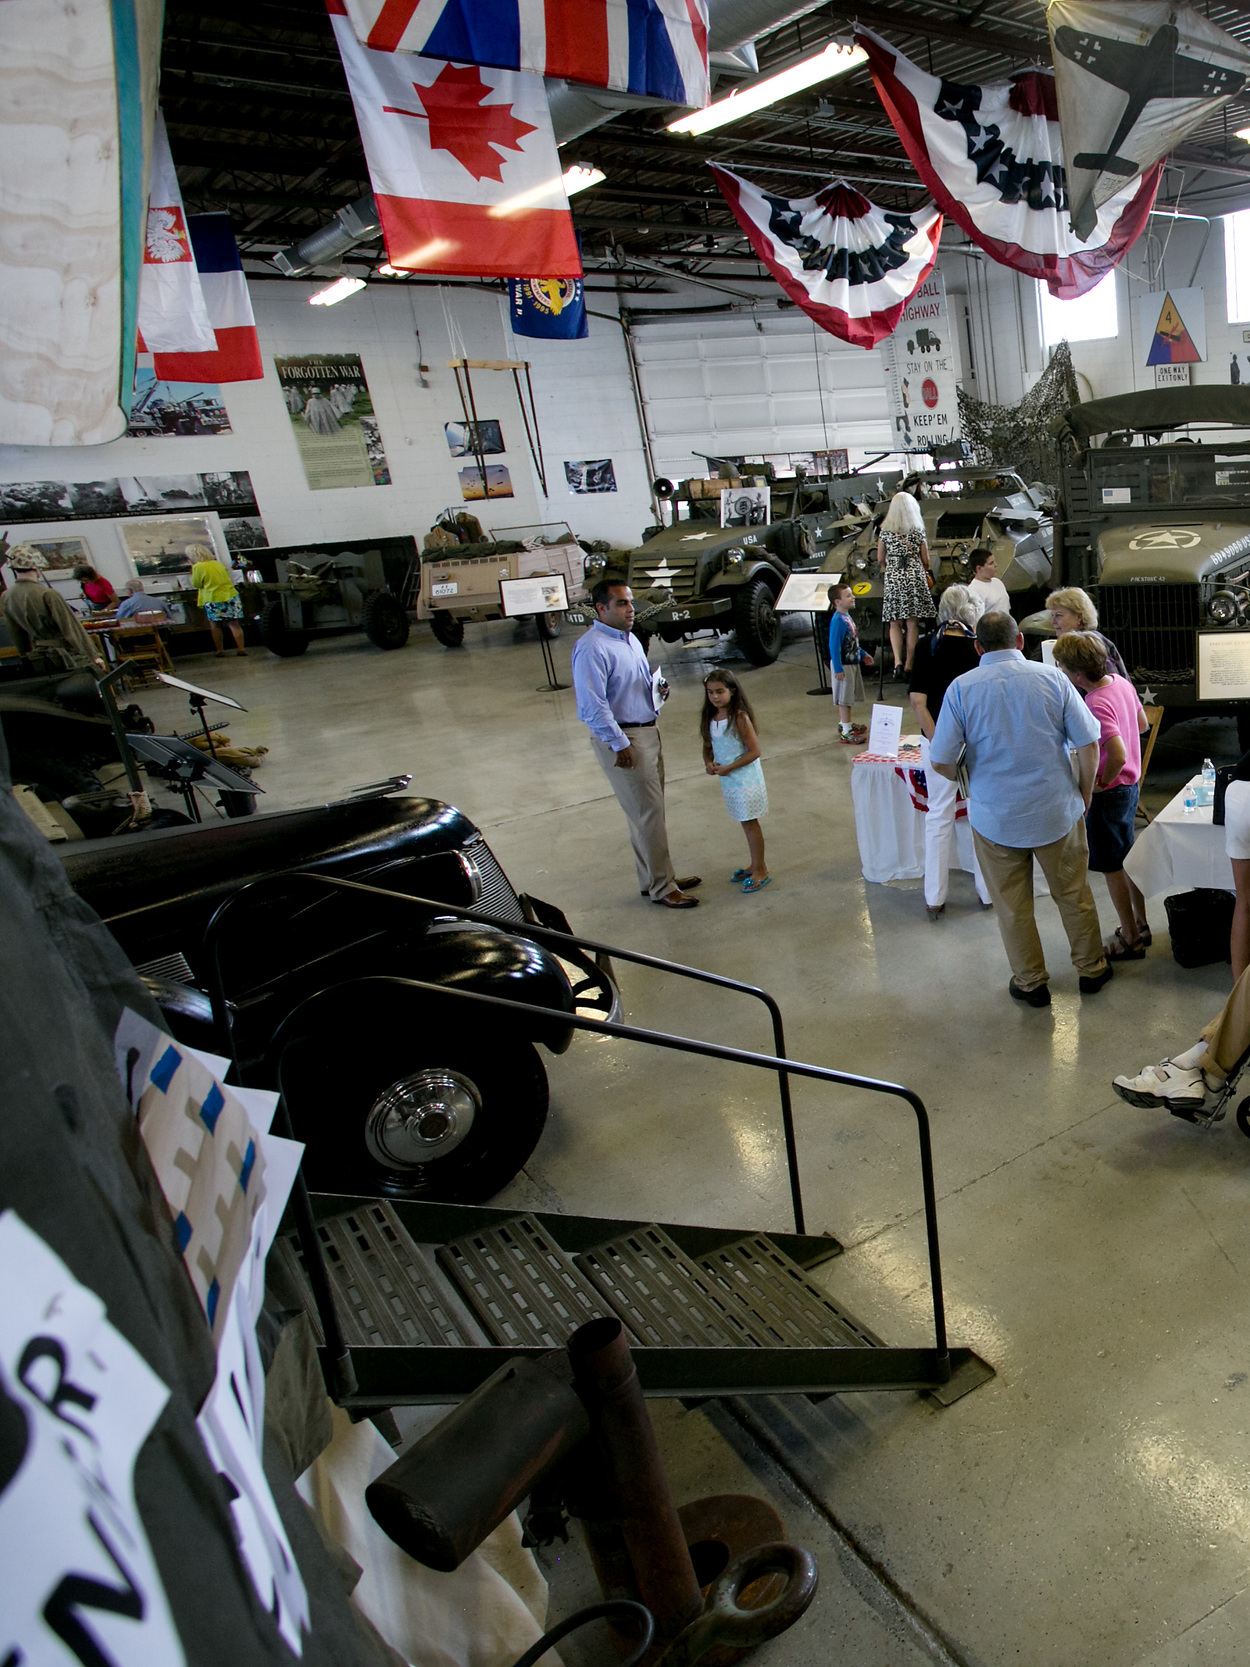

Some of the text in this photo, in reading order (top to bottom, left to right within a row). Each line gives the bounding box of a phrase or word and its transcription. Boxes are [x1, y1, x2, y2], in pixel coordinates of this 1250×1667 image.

[515, 284, 523, 305] WAR
[917, 282, 940, 299] BALL
[900, 303, 940, 322] HIGHWAY
[1165, 311, 1172, 324] 4
[281, 365, 361, 379] FORGOTTEN WAR
[907, 358, 948, 375] STAY ON THE
[1174, 366, 1186, 374] WAY
[743, 535, 758, 545] USA
[672, 610, 691, 621] R-2
